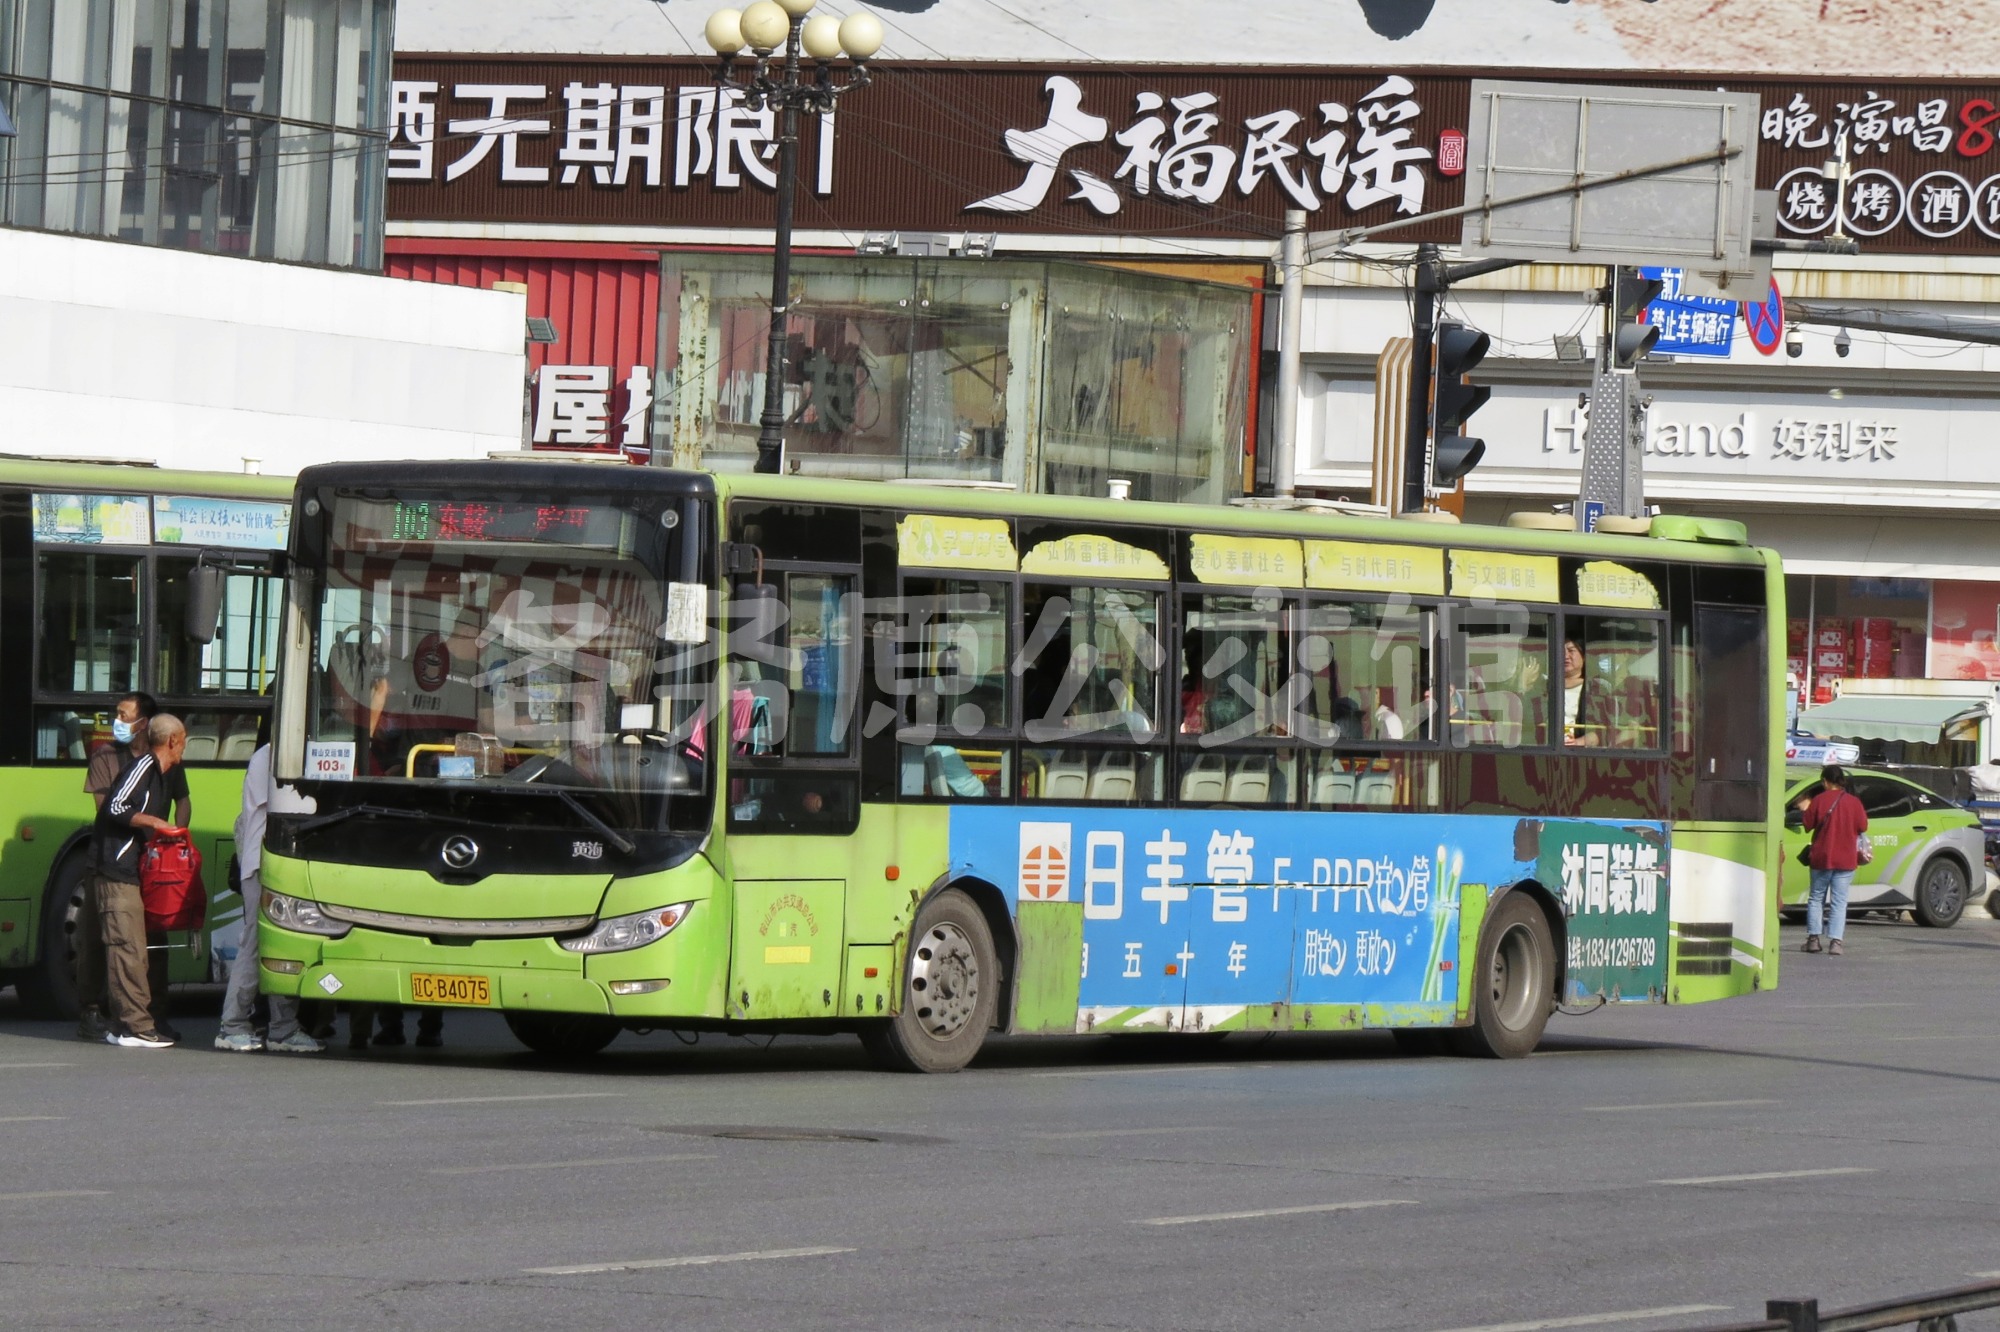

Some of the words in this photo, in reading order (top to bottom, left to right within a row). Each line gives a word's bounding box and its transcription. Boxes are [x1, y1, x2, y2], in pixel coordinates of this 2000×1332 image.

[963, 75, 1433, 215] 大福民谣
[1774, 417, 1899, 460] 好利来
[180, 505, 274, 530] 社会主义核心价值观
[1047, 540, 1142, 565] 弘扬雷锋精神
[1192, 548, 1285, 574] 爱心奉献社会
[1341, 555, 1413, 581] 与时代同行
[1466, 563, 1537, 590] 与文明相随
[572, 841, 603, 859] 黄海
